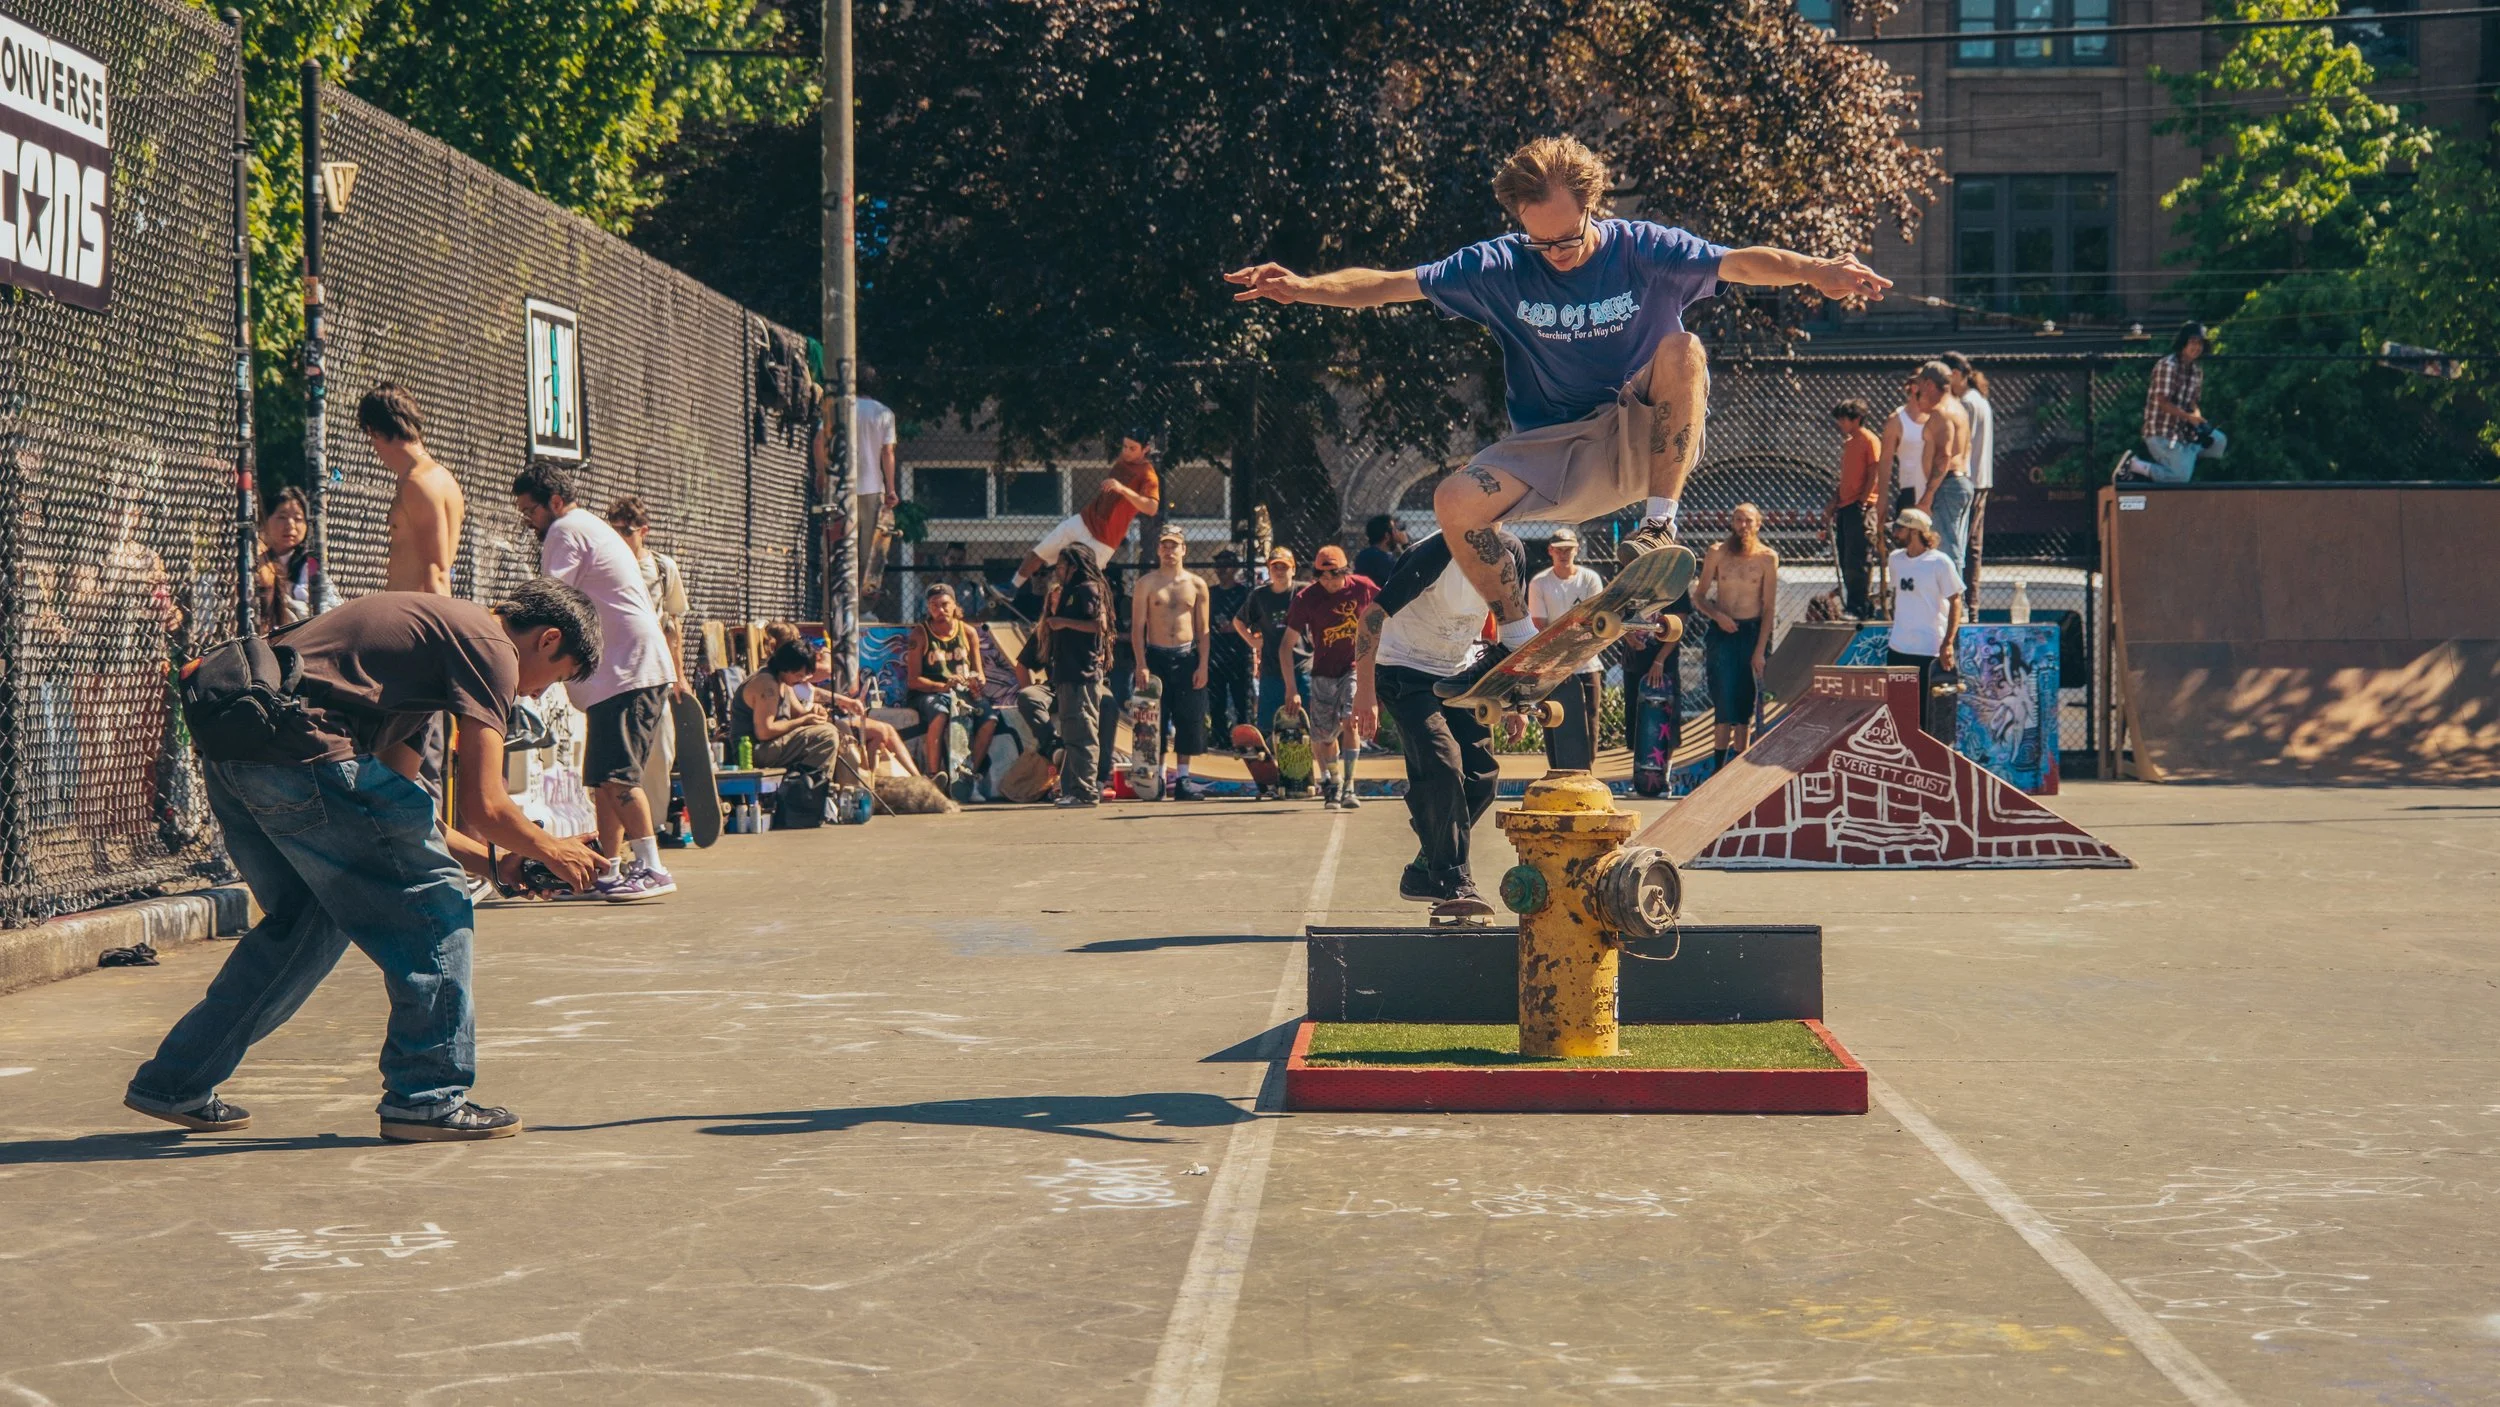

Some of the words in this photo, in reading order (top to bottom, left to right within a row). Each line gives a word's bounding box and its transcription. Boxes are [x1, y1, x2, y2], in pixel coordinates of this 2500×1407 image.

[0, 36, 104, 130] ONVERSE
[1537, 329, 1572, 343] Searching
[1574, 330, 1587, 339] For
[1593, 327, 1609, 338] Way
[1610, 322, 1624, 334] Out
[1864, 677, 1887, 697] HUT
[1889, 673, 1918, 683] POPS
[1865, 726, 1892, 744] POPS
[1834, 755, 1901, 782] EVERETT
[1904, 772, 1949, 795] CRUST
